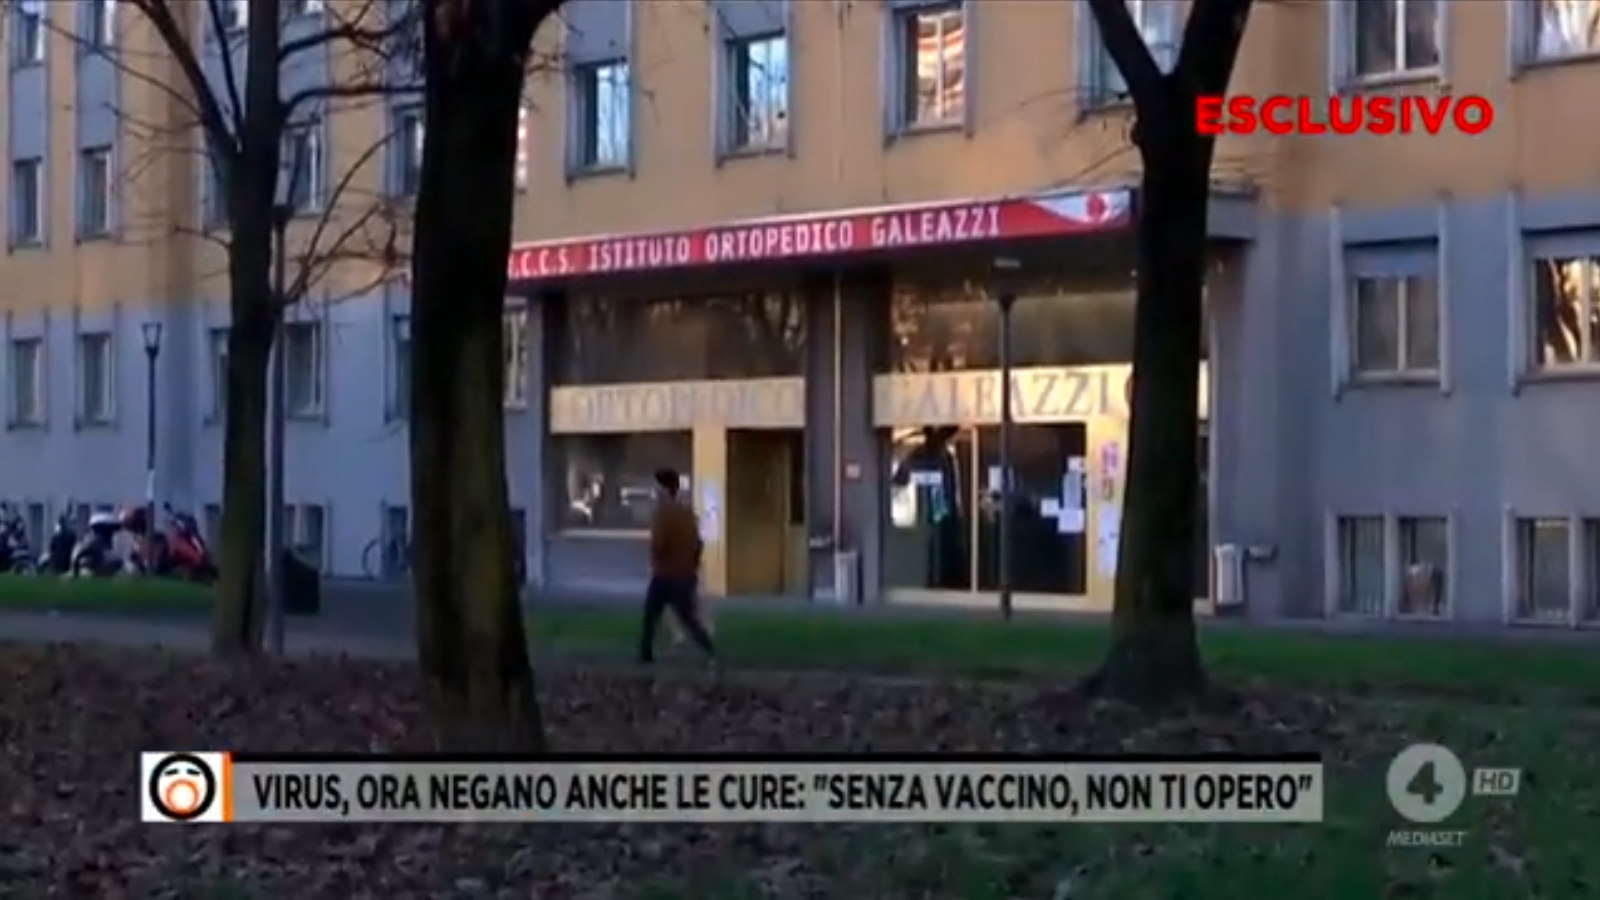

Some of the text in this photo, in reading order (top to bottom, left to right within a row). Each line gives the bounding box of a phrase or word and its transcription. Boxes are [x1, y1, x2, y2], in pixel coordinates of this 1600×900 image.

[588, 236, 691, 273] ISTITUTO
[704, 219, 853, 262] ORTOPEDICO
[871, 205, 1000, 248] GALEAZZI
